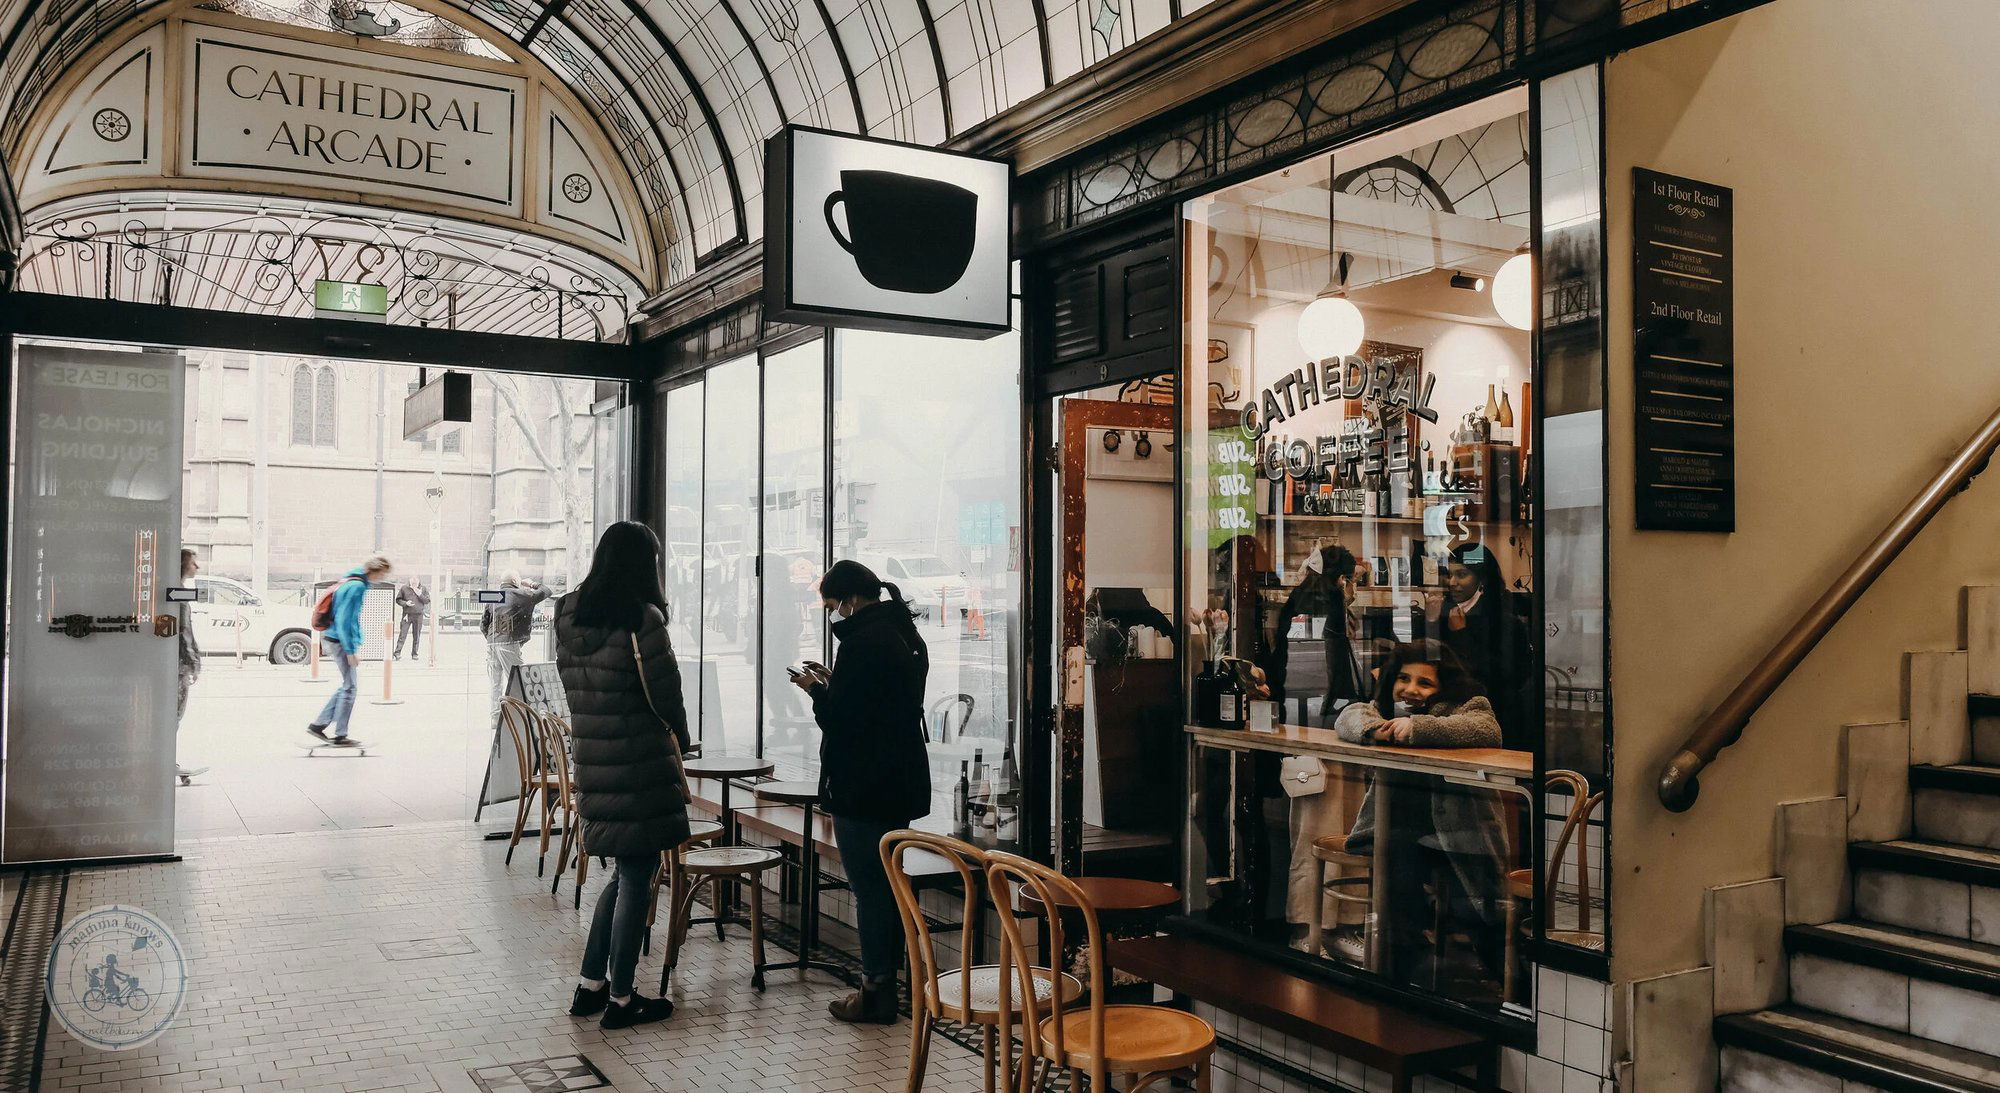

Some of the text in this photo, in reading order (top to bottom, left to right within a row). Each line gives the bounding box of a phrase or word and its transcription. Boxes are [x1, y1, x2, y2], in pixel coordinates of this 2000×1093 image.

[226, 64, 494, 135] CATHEDRAL
[265, 120, 448, 175] ARCADE
[1653, 181, 1720, 208] 1st Floor Retail
[1651, 301, 1722, 326] 2nd Floor Retail
[1100, 364, 1108, 382] 9
[1241, 355, 1438, 441] CATHEDRAL
[1264, 425, 1410, 483] COFFEE
[1314, 487, 1366, 514] WINE
